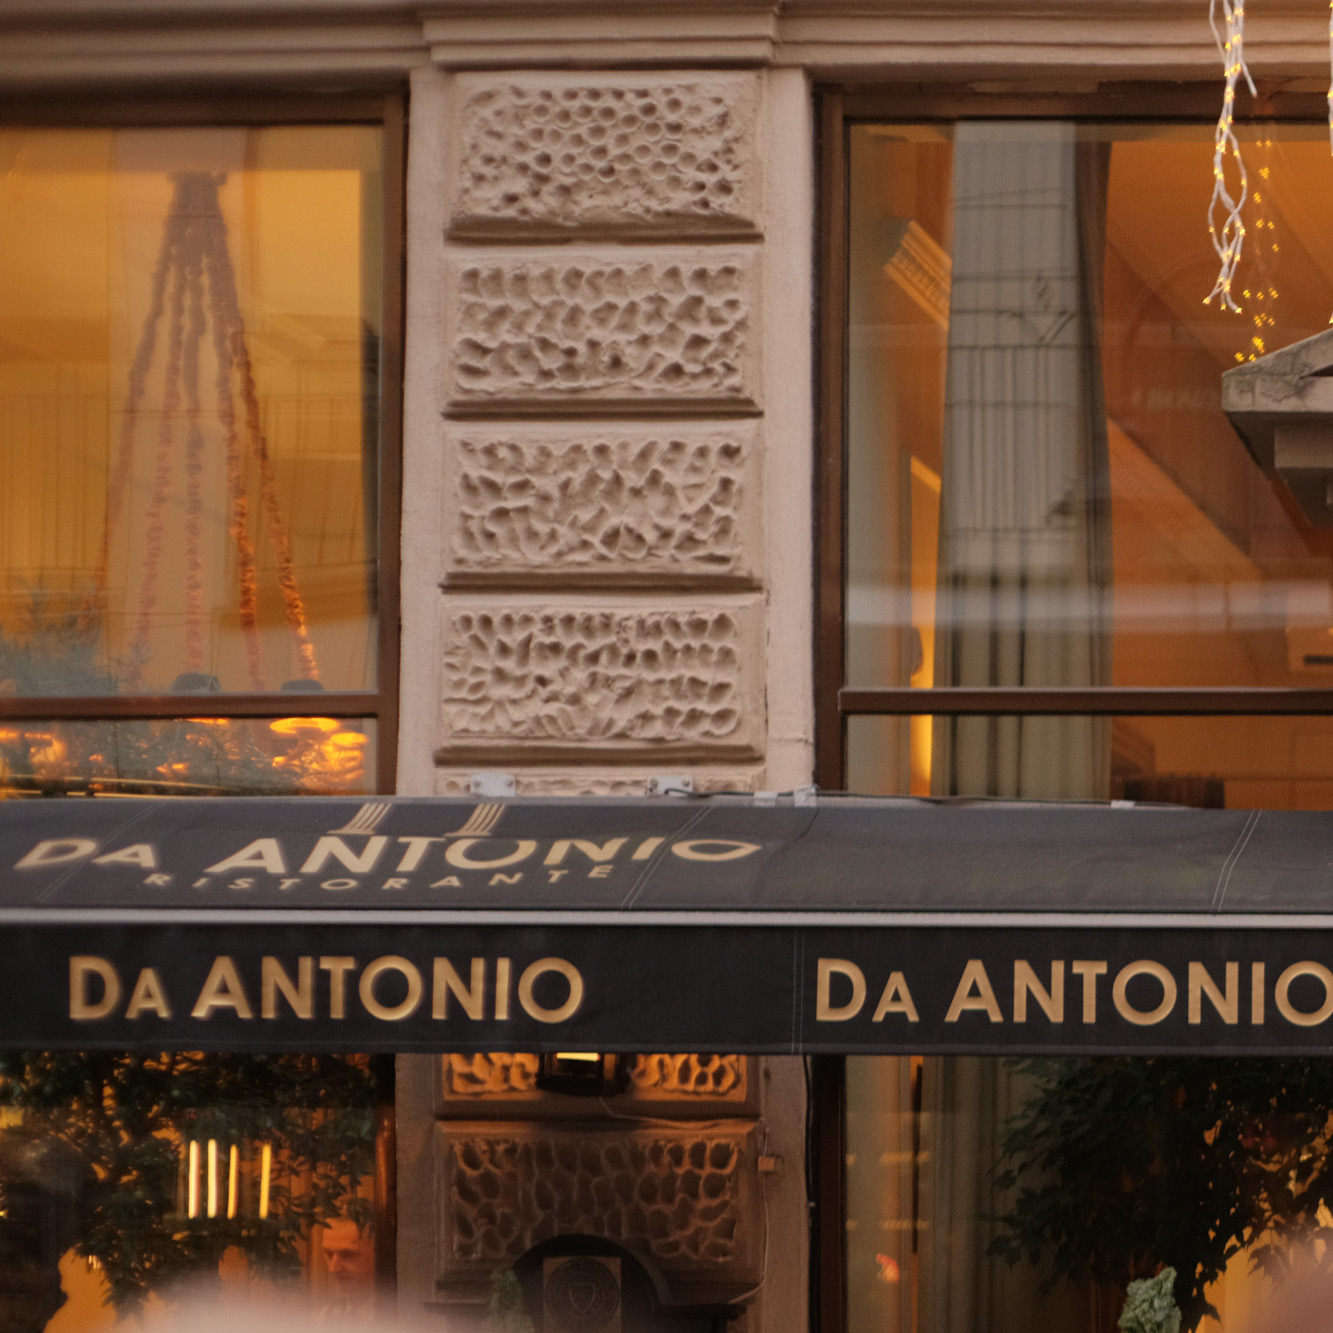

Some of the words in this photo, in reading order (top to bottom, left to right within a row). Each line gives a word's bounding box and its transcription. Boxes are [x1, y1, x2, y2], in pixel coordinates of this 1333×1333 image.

[13, 837, 157, 870] DA
[203, 834, 762, 875] ANTONIO
[143, 864, 614, 891] RISTORANTE
[69, 956, 171, 1020] DA
[190, 955, 584, 1024] ANTONIO
[816, 958, 920, 1022] DA
